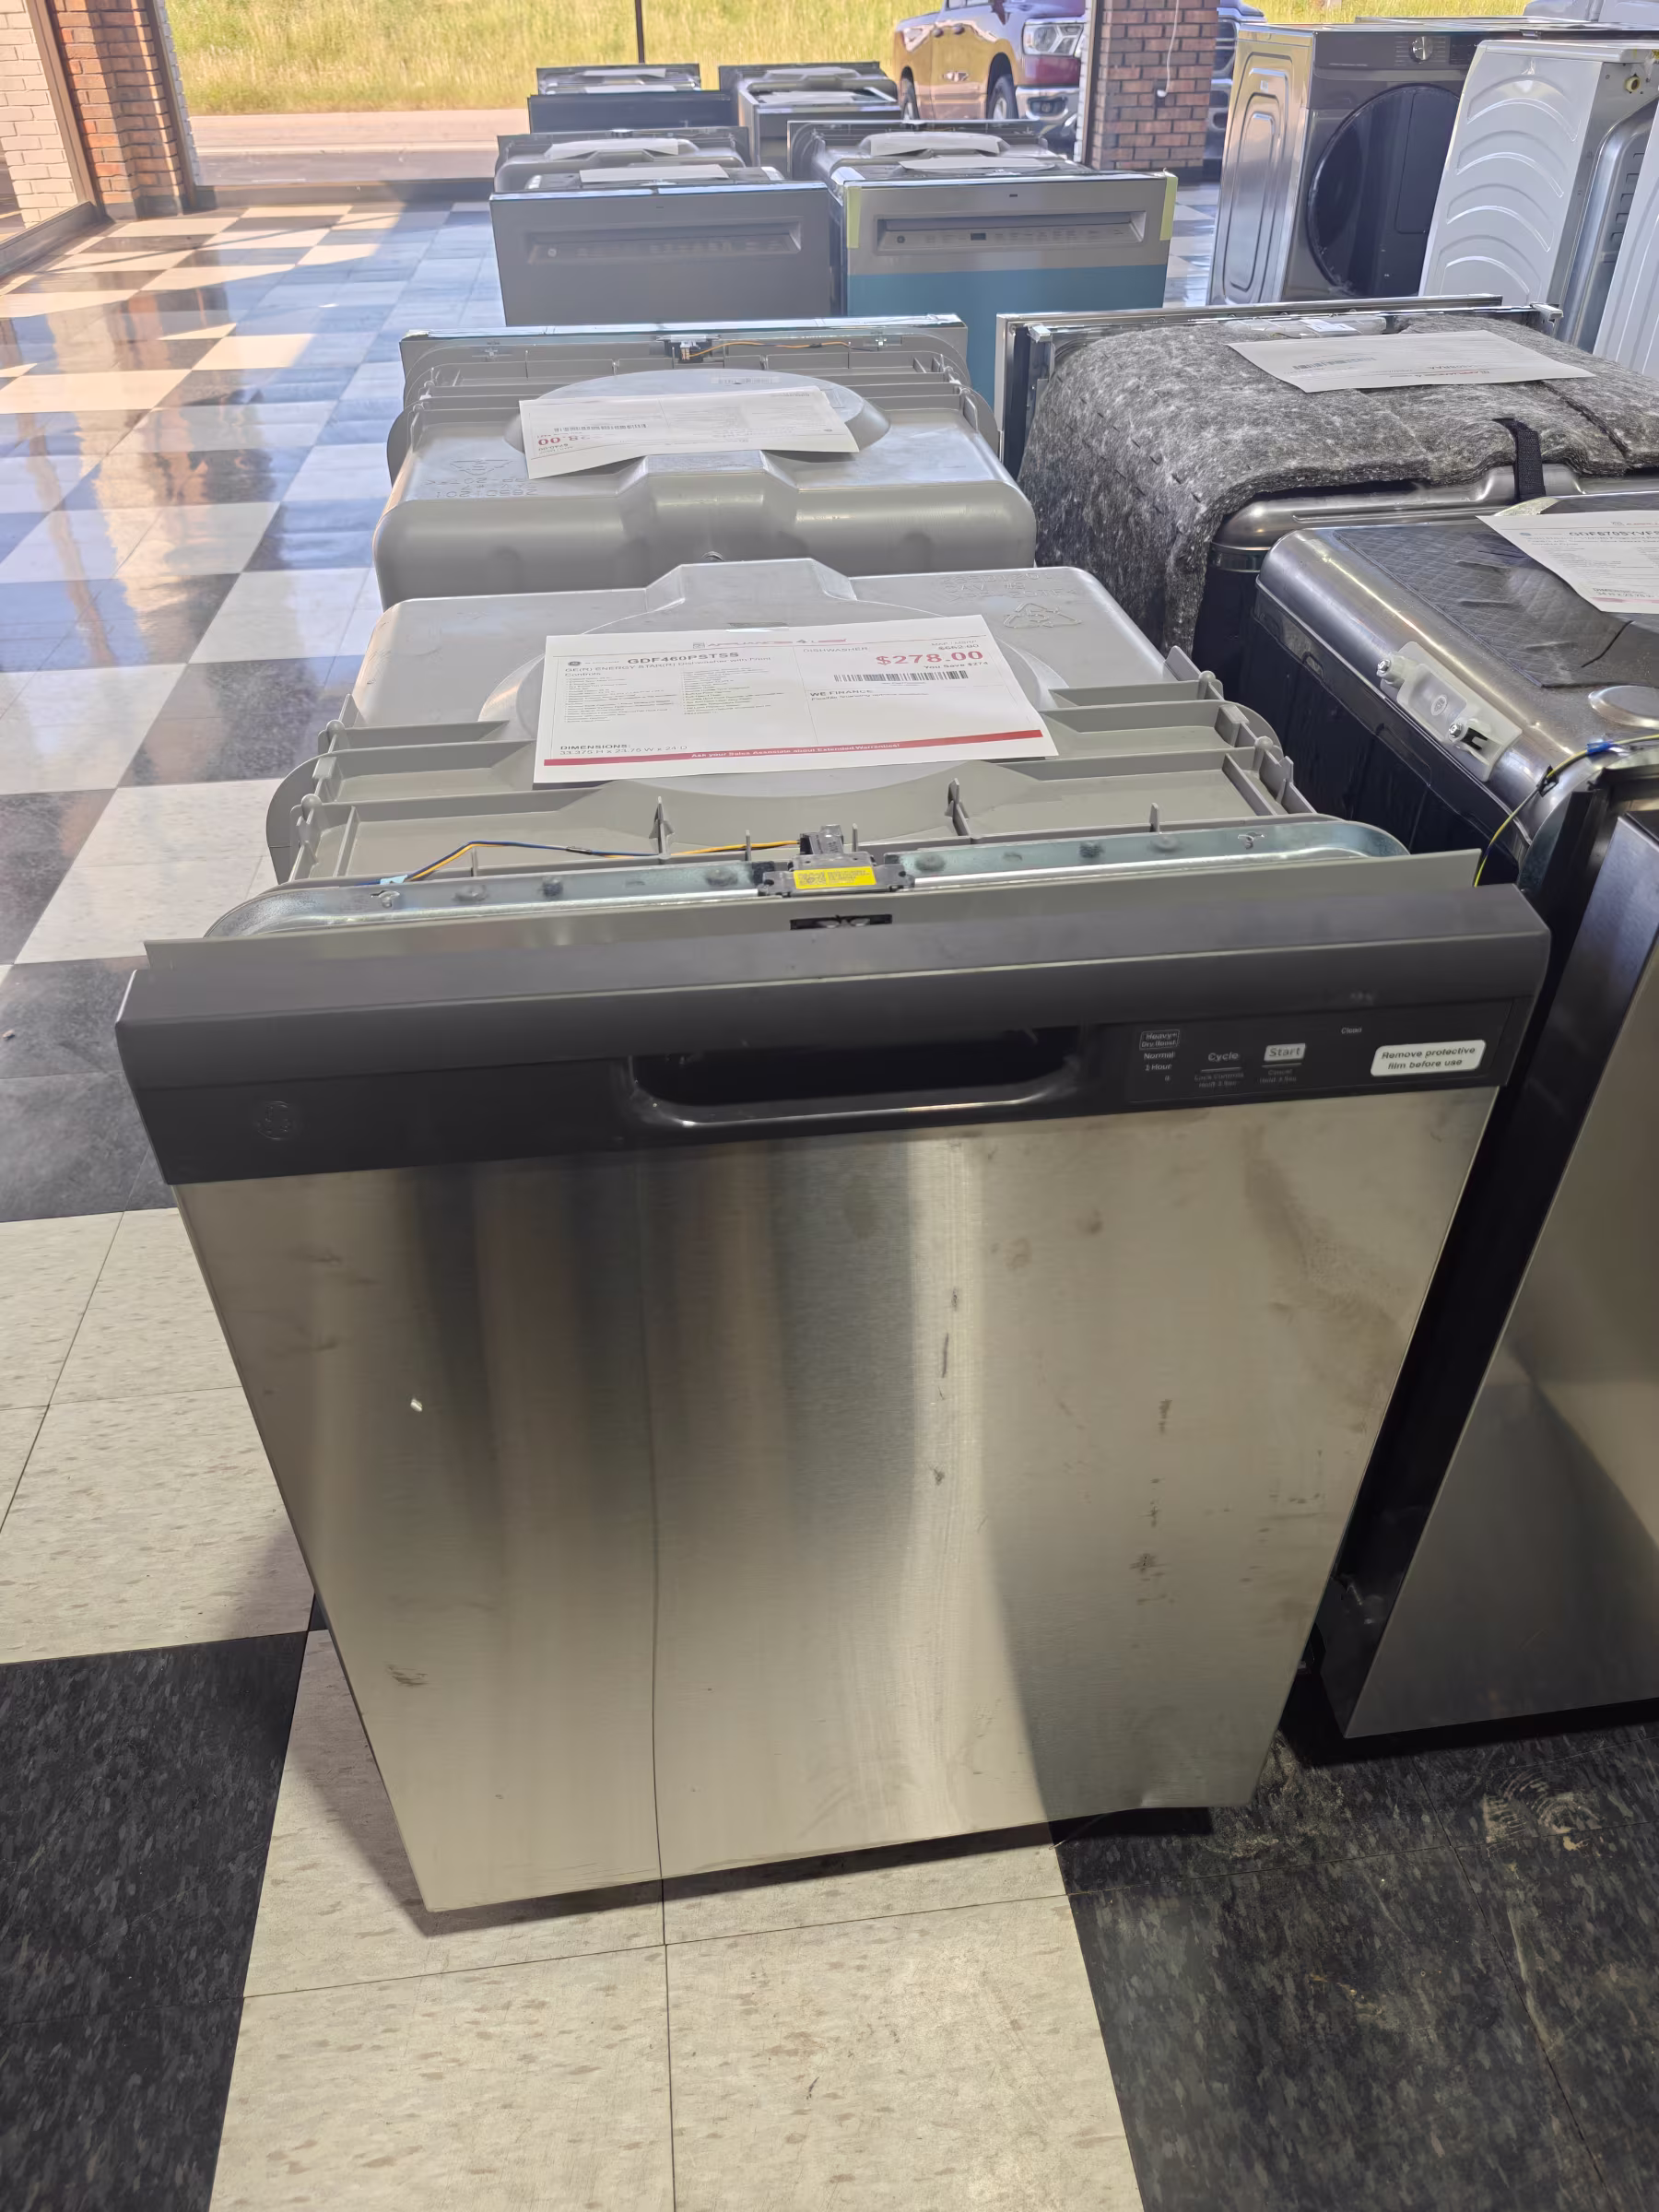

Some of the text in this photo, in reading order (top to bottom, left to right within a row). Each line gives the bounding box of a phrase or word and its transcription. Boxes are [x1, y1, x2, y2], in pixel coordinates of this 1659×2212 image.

[627, 652, 739, 665] GDF460PSTSS
[876, 651, 983, 665] $278.00
[1144, 1051, 1175, 1060] Normal
[1268, 1045, 1301, 1057] Start
[1381, 1046, 1477, 1060] Remove protective
[1207, 1052, 1240, 1063] Cycle
[1387, 1062, 1406, 1071] film
[1408, 1060, 1441, 1069] before
